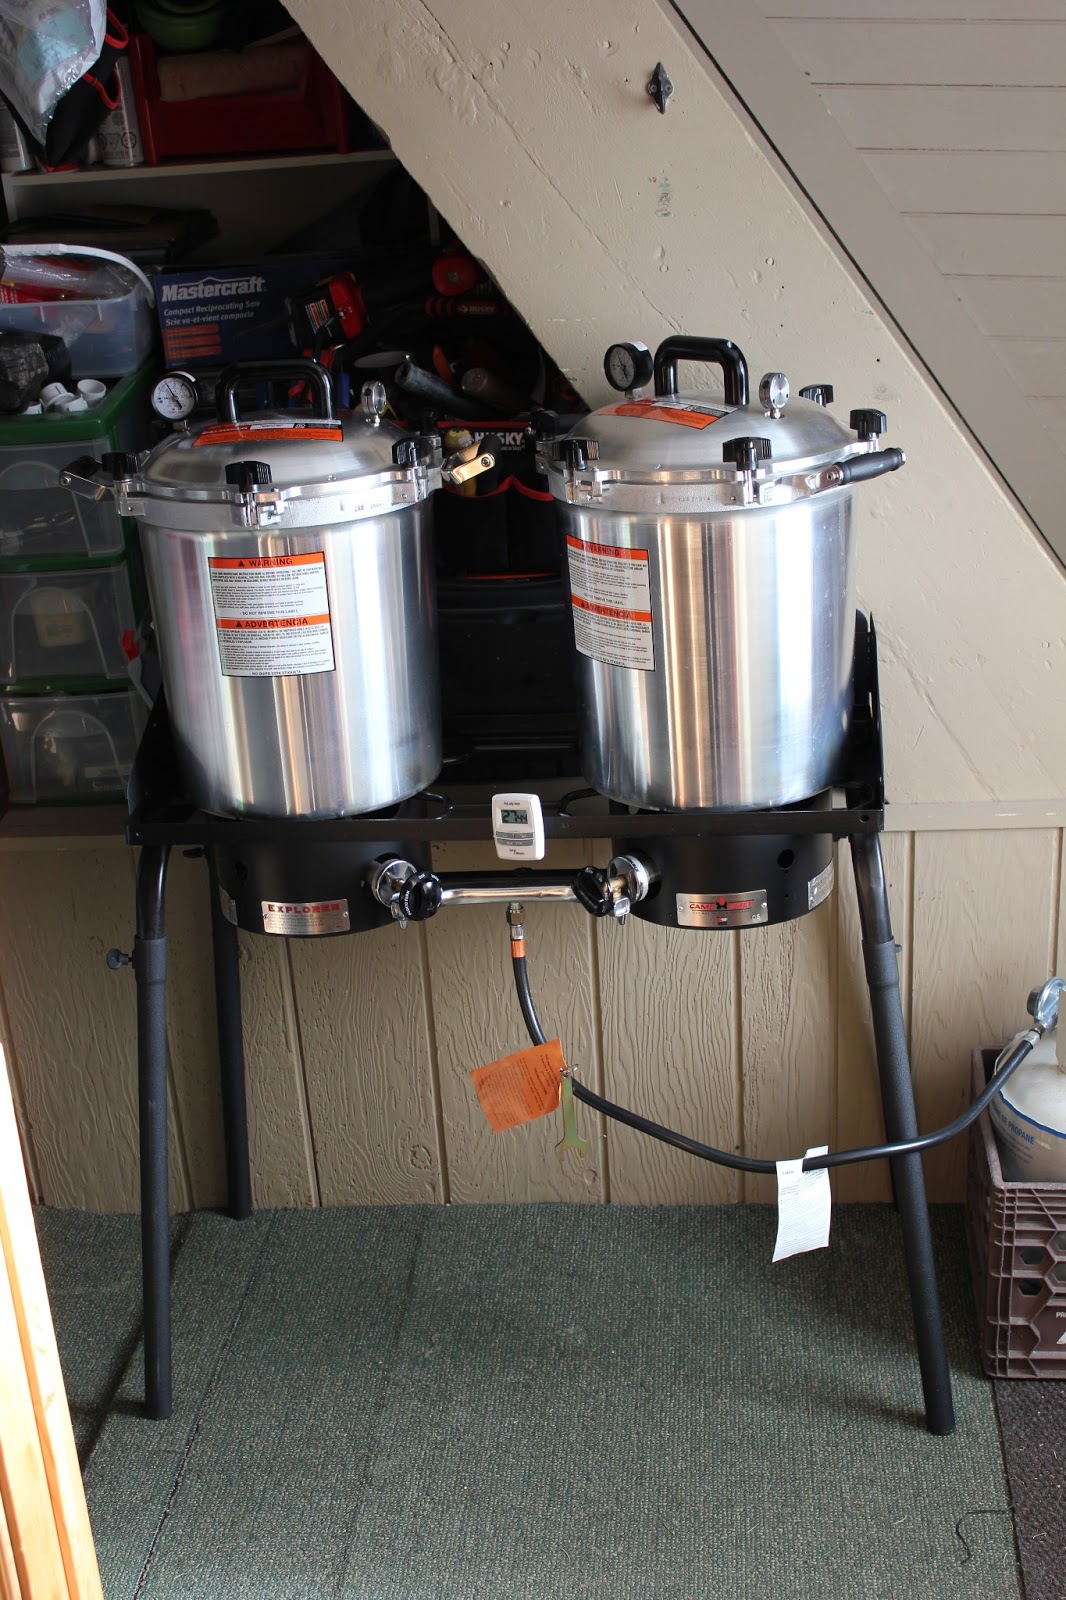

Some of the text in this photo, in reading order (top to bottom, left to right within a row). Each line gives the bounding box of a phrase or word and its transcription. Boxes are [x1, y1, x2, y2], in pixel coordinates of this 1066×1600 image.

[162, 276, 266, 302] Mastercraft
[164, 300, 261, 317] Compact Reciprocating Saw
[165, 311, 254, 326] Scie va-et-vient compacte
[474, 431, 524, 446] HSKY
[586, 543, 620, 557] WARNING
[248, 557, 293, 567] WARNING
[585, 601, 632, 619] ADVERTENCIA
[245, 618, 308, 628] ADVERTENCIA
[267, 903, 340, 914] EXPLORER
[1007, 1120, 1035, 1145] PROPANE
